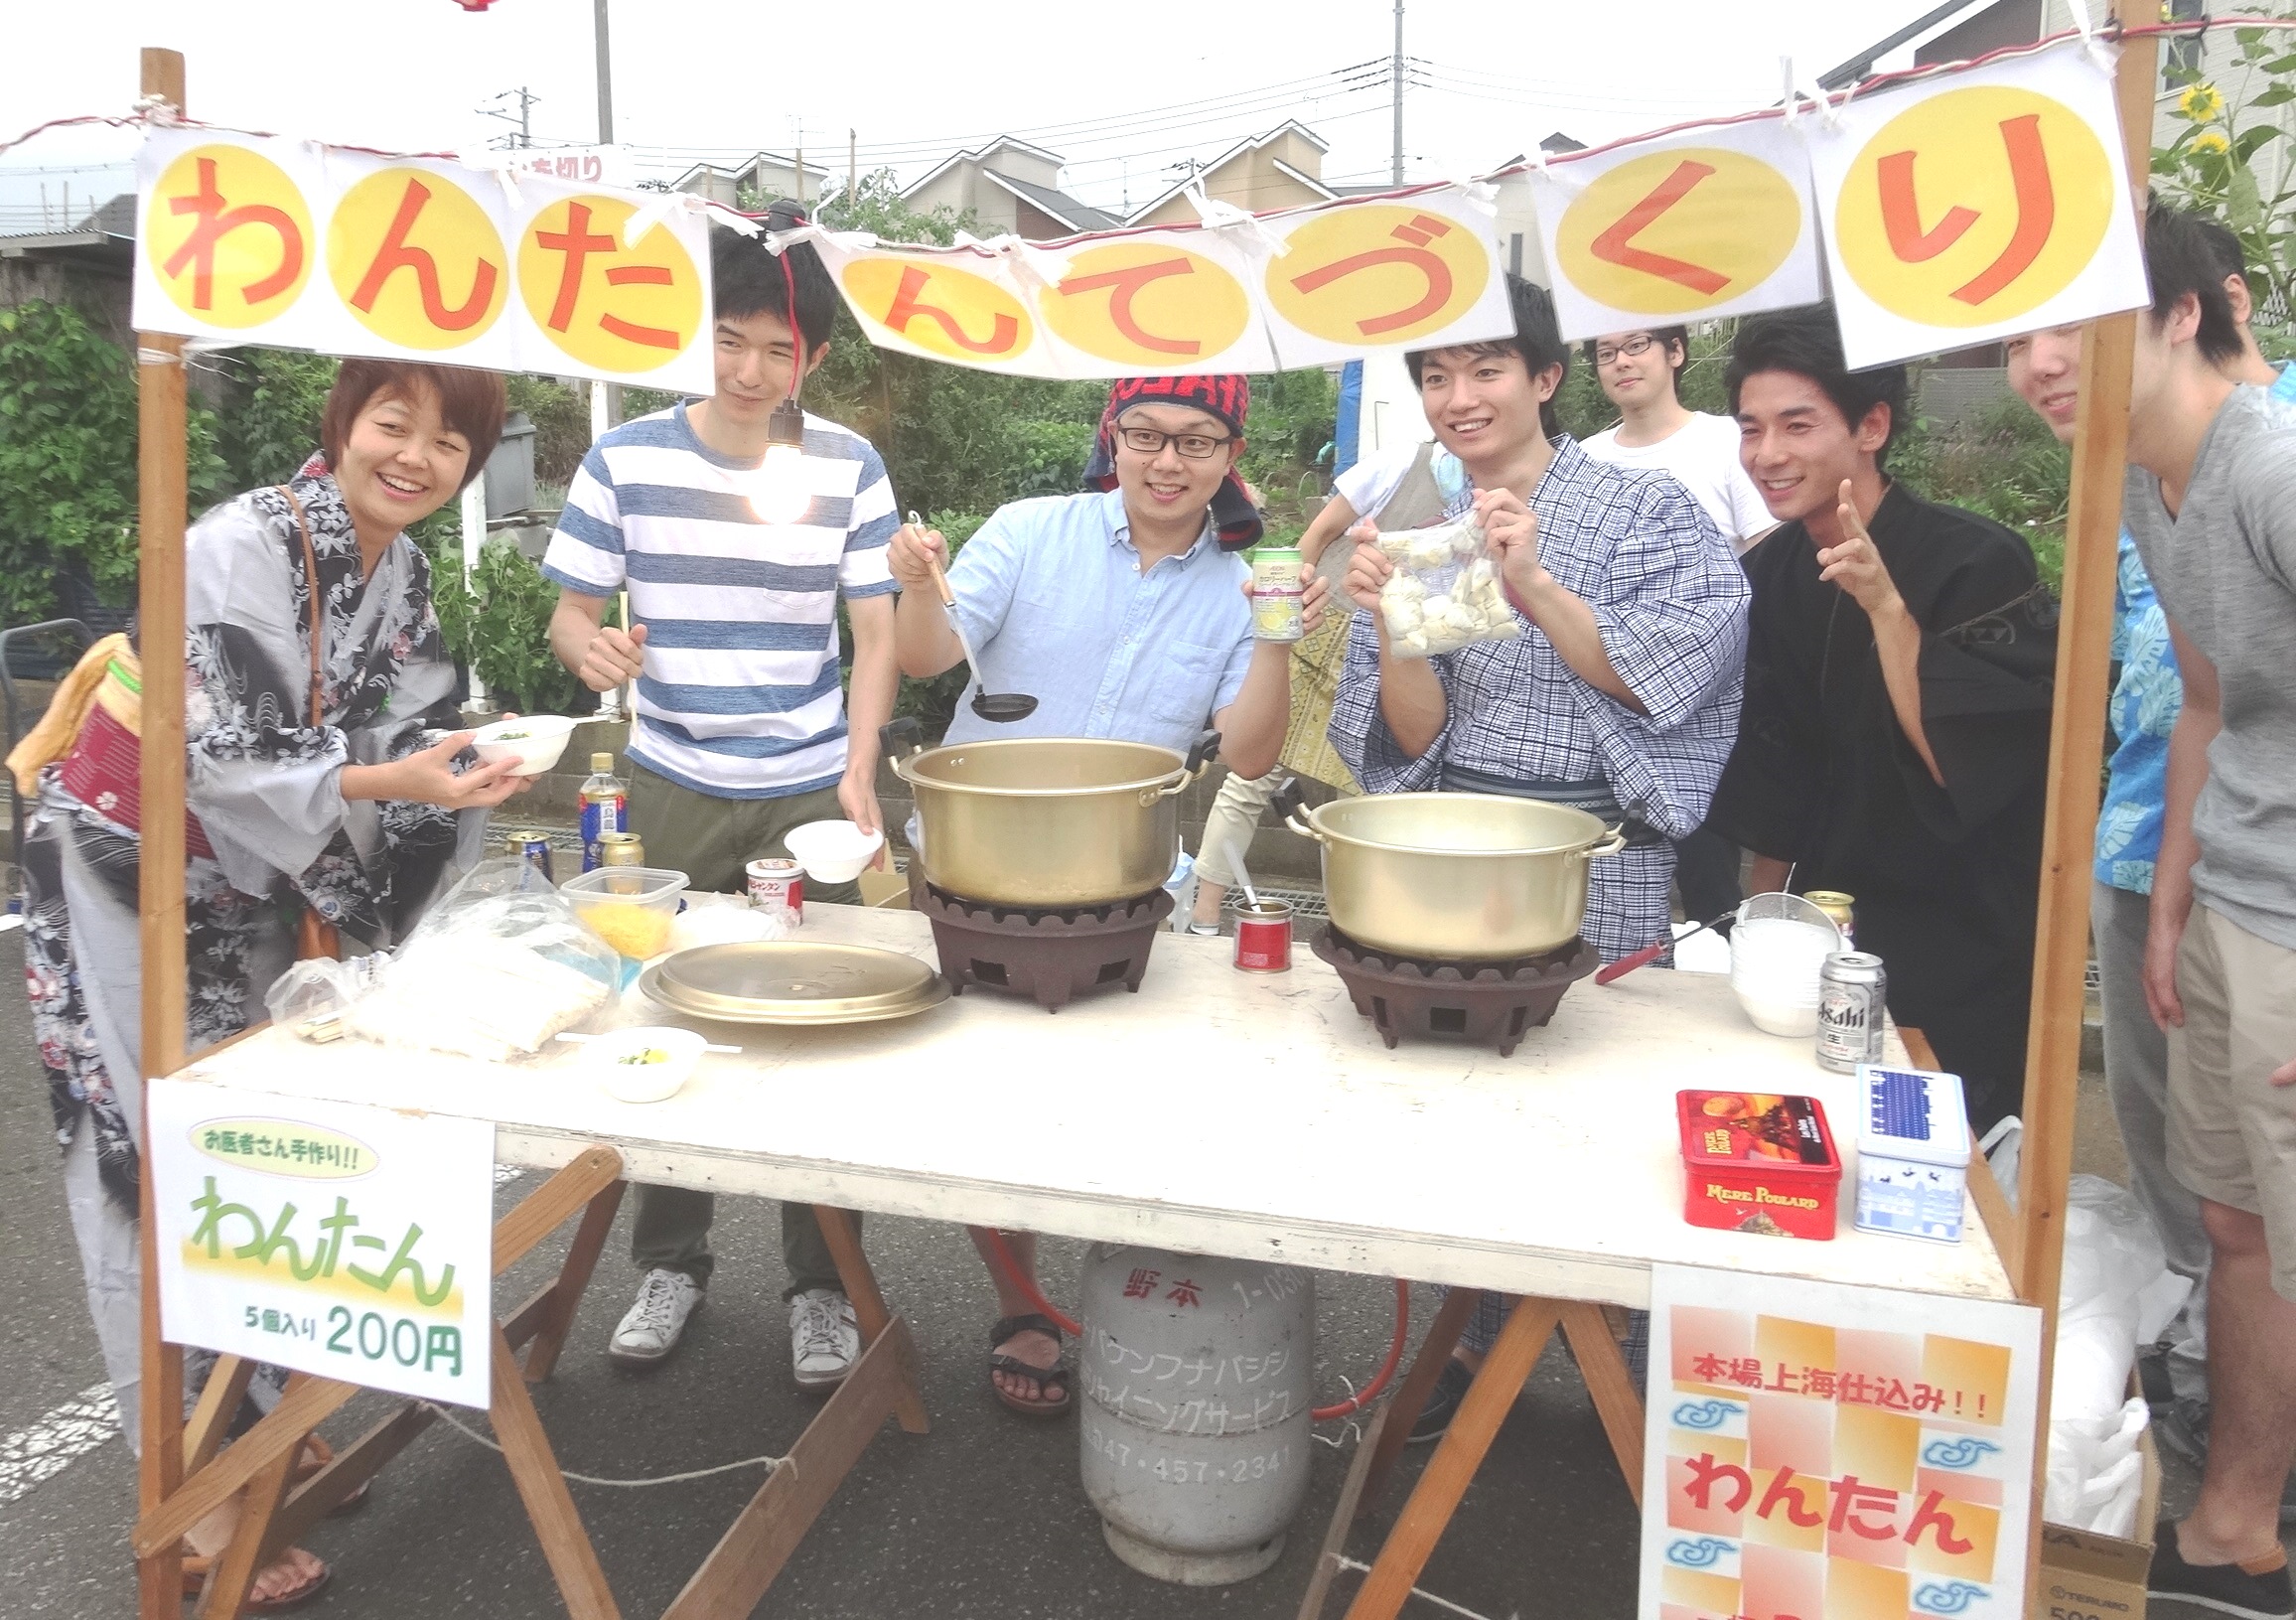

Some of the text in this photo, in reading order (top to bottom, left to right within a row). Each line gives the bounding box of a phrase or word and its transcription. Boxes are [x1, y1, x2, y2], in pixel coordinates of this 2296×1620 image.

[1817, 1001, 1865, 1029] Asahi
[190, 1176, 456, 1306] わんたん
[245, 1305, 463, 1377] 5個入り 200円
[1683, 1452, 1973, 1555] わんたん
